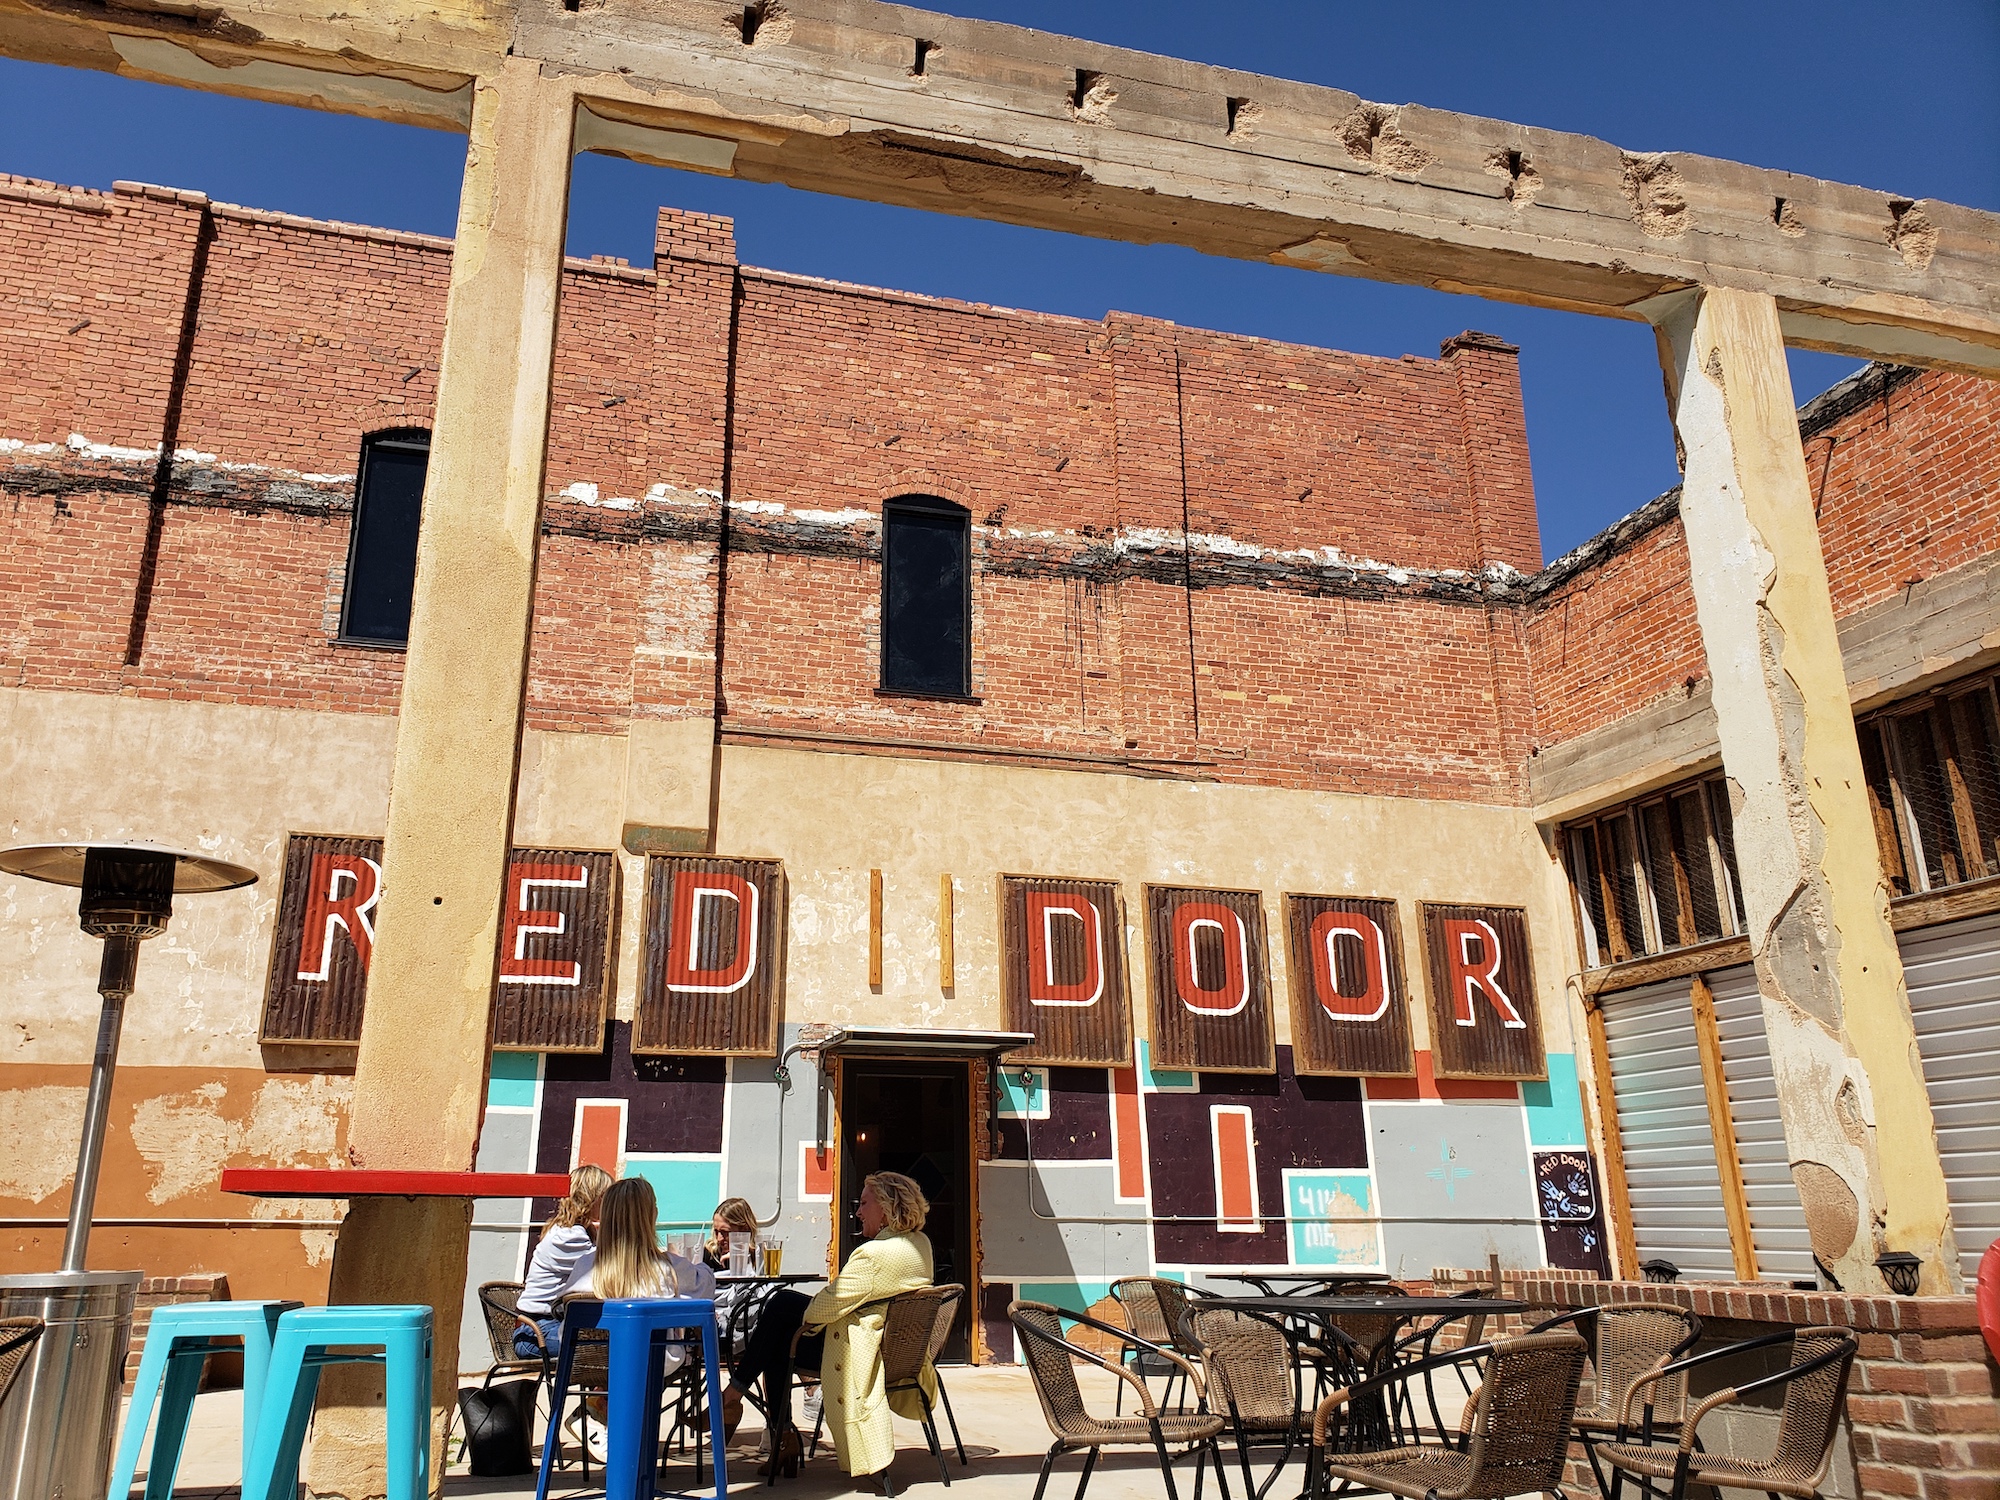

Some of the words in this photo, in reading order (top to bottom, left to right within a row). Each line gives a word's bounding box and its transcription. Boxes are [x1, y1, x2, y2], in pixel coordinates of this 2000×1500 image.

[297, 853, 759, 994] RED
[1026, 892, 1527, 1030] DOOR
[1540, 1156, 1559, 1175] RED
[1560, 1154, 1587, 1173] DOOR
